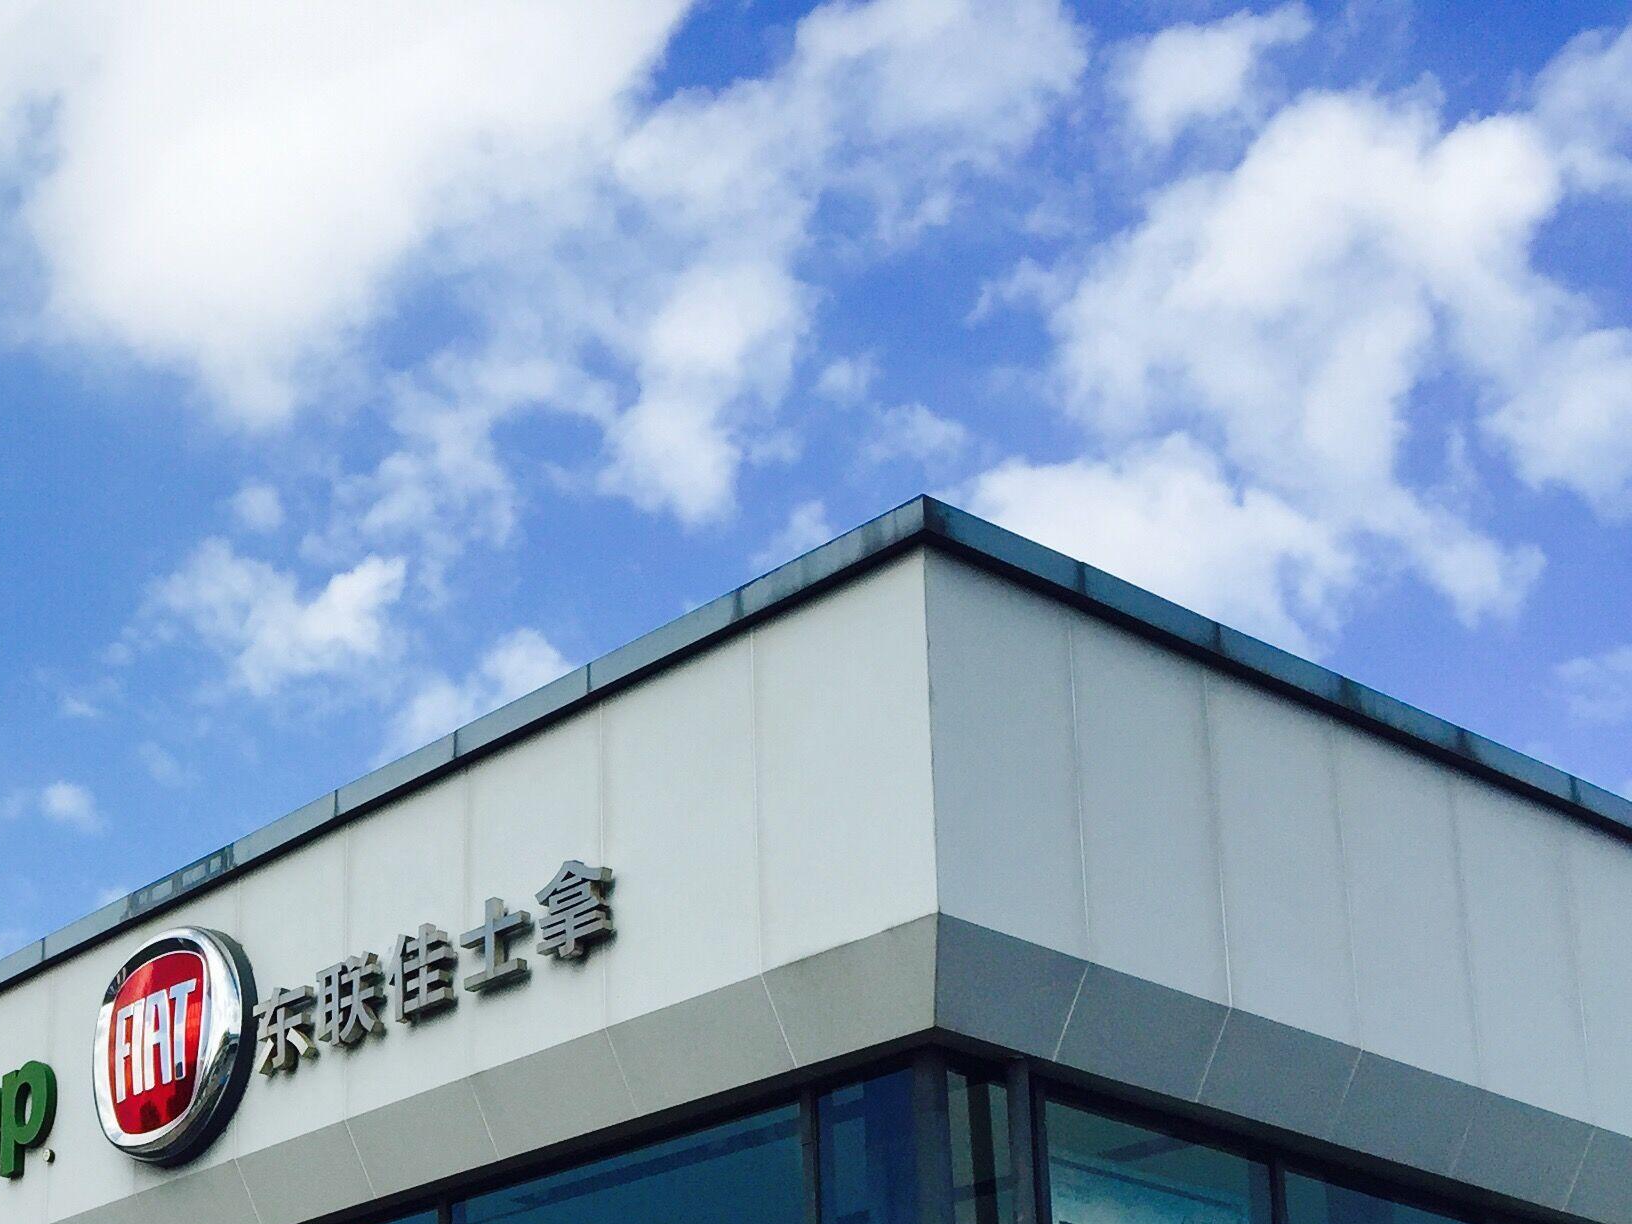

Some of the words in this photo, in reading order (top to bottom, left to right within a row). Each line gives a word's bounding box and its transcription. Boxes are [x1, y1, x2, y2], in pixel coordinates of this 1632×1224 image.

[115, 978, 197, 1104] FIAT
[253, 859, 612, 1076] 东联佳士拿
